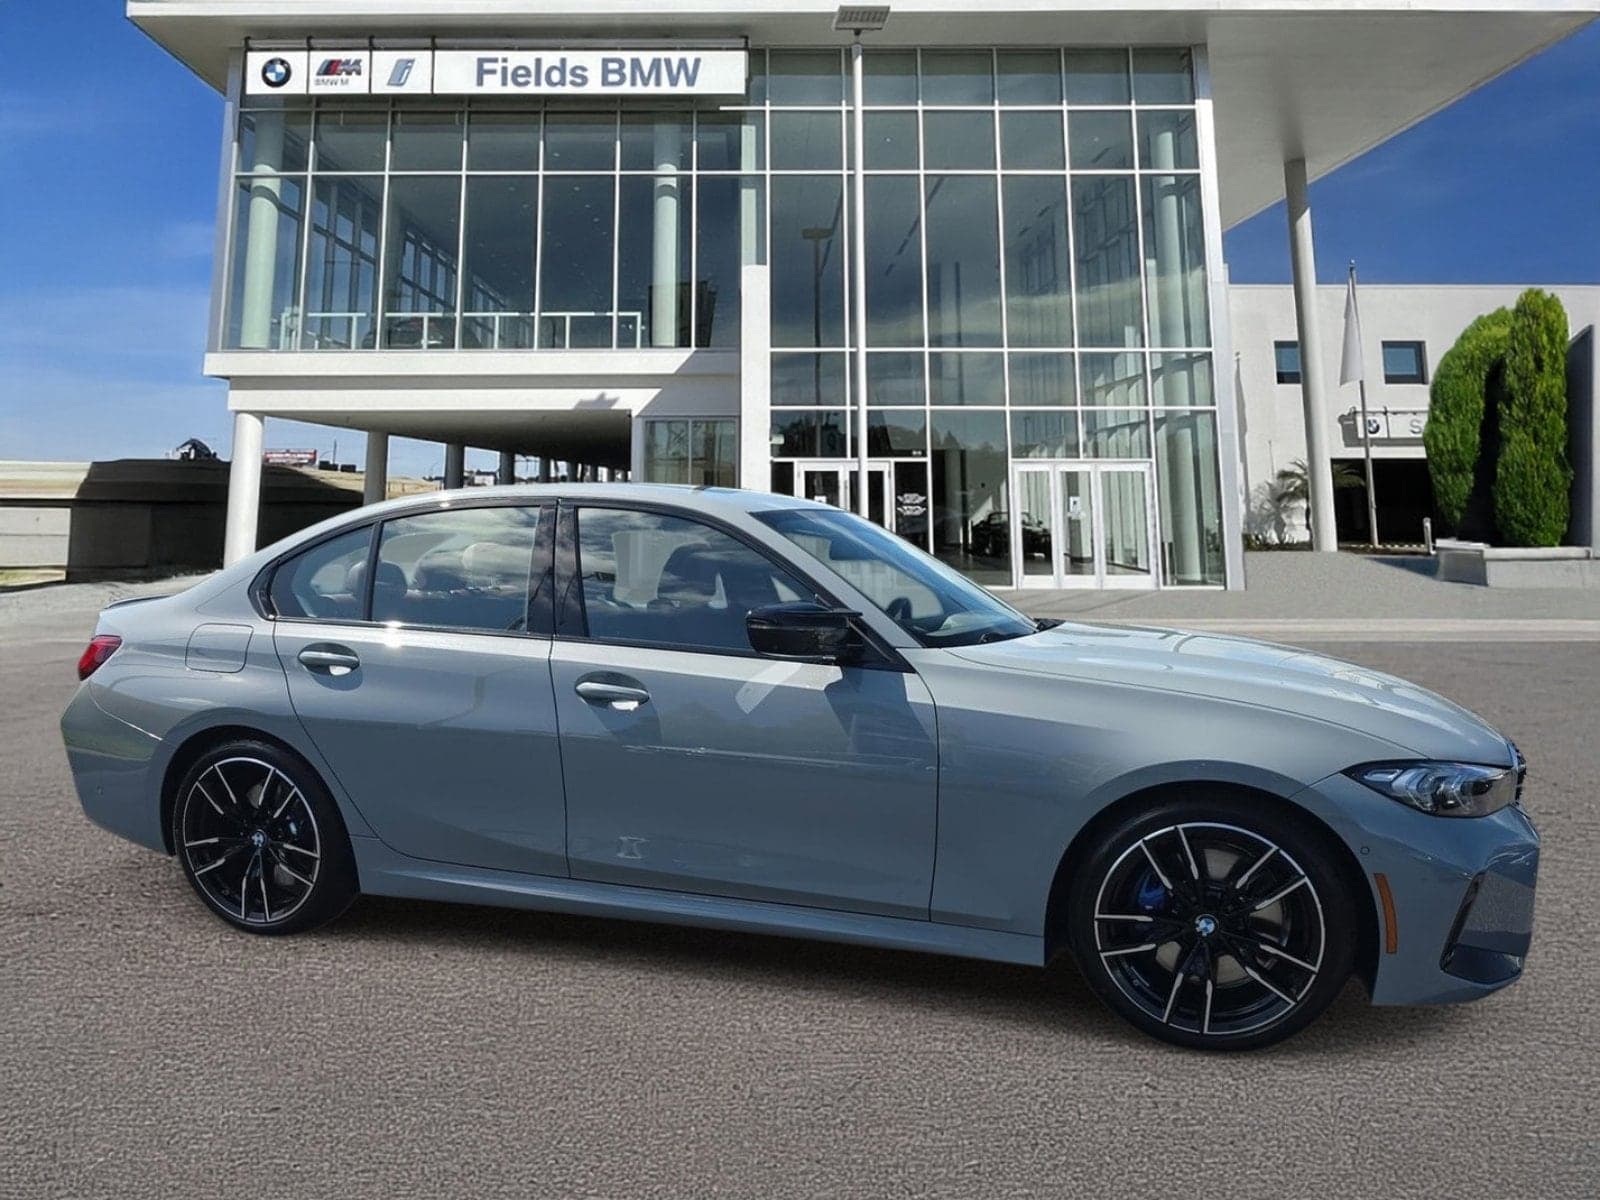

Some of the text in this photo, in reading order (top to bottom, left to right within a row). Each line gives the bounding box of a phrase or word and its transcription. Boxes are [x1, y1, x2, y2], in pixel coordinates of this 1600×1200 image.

[476, 57, 701, 87] Fields BMW
[1409, 418, 1423, 435] S
